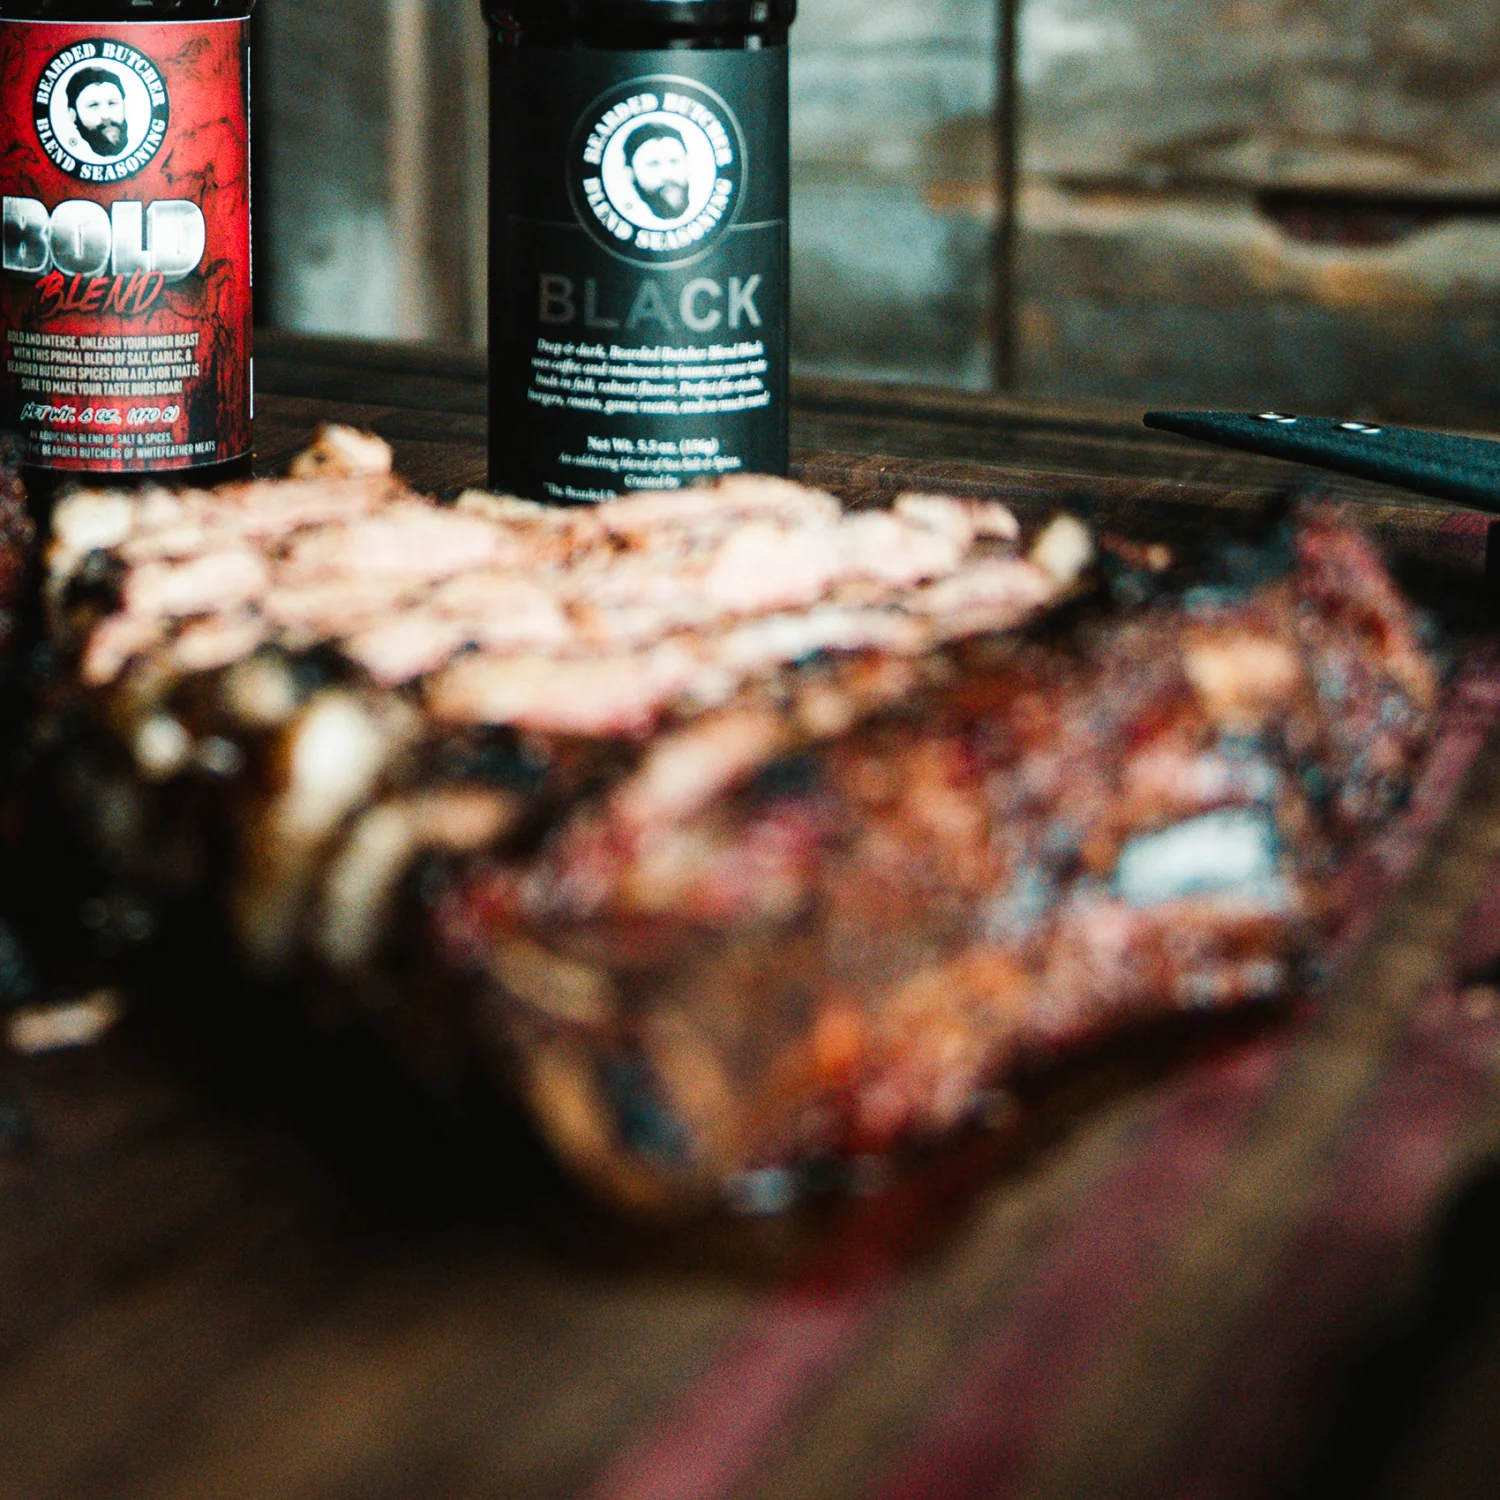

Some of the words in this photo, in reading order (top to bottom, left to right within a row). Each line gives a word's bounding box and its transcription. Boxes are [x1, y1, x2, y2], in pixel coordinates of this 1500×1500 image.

[36, 43, 96, 105] BEARDED
[101, 42, 166, 107] BUTCHER
[583, 92, 658, 165] BEARDED
[662, 92, 733, 167] BUTCHER
[36, 118, 75, 172] BLEND
[79, 119, 166, 181] SEASONING
[583, 177, 633, 241] BLEND
[634, 178, 733, 251] SEASONING
[2, 196, 206, 279] BOLD
[35, 269, 164, 316] BLEND
[538, 274, 763, 332] BLACK
[7, 329, 24, 344] BOLD
[25, 332, 40, 345] AND
[80, 336, 121, 350] UNLEASH
[123, 336, 147, 350] YOUR
[148, 335, 174, 349] INNER
[175, 333, 199, 347] BEAST
[537, 338, 562, 355] Deep
[609, 345, 661, 361] Bearded
[661, 345, 707, 361] Butcher
[14, 346, 31, 360] WITH
[32, 348, 50, 361] THIS
[50, 350, 83, 364] PRIMAL
[84, 351, 113, 365] BLEND
[114, 352, 126, 365] OF
[7, 360, 37, 375] BEARDED
[39, 364, 77, 378] BUTCHER
[78, 366, 110, 381] SPICES
[111, 367, 129, 381] FOR
[130, 367, 137, 381] A
[137, 366, 171, 380] FLAVOR
[171, 364, 191, 378] THAT
[192, 363, 200, 376] IS
[551, 359, 581, 374] coffee
[583, 361, 608, 376] and
[662, 365, 677, 379] to
[21, 377, 40, 391] SURE
[41, 379, 51, 393] TO
[52, 380, 77, 394] MAKE
[78, 382, 102, 395] YOUR
[103, 382, 131, 396] TASTE
[131, 382, 155, 395] BUDS
[20, 401, 52, 421] NET
[49, 404, 76, 423] WT.
[78, 408, 94, 424] 6
[604, 400, 638, 415] game
[39, 430, 77, 442] ADDICTING
[78, 433, 104, 444] BLEND
[105, 434, 115, 444] OF
[117, 434, 135, 445] SALT
[587, 435, 611, 452] Net
[42, 444, 77, 457] BEARDED
[79, 446, 121, 459] BUTCHERS
[124, 447, 134, 458] OF
[136, 443, 194, 459] WHITEFEATHER
[195, 440, 216, 453] MEATS
